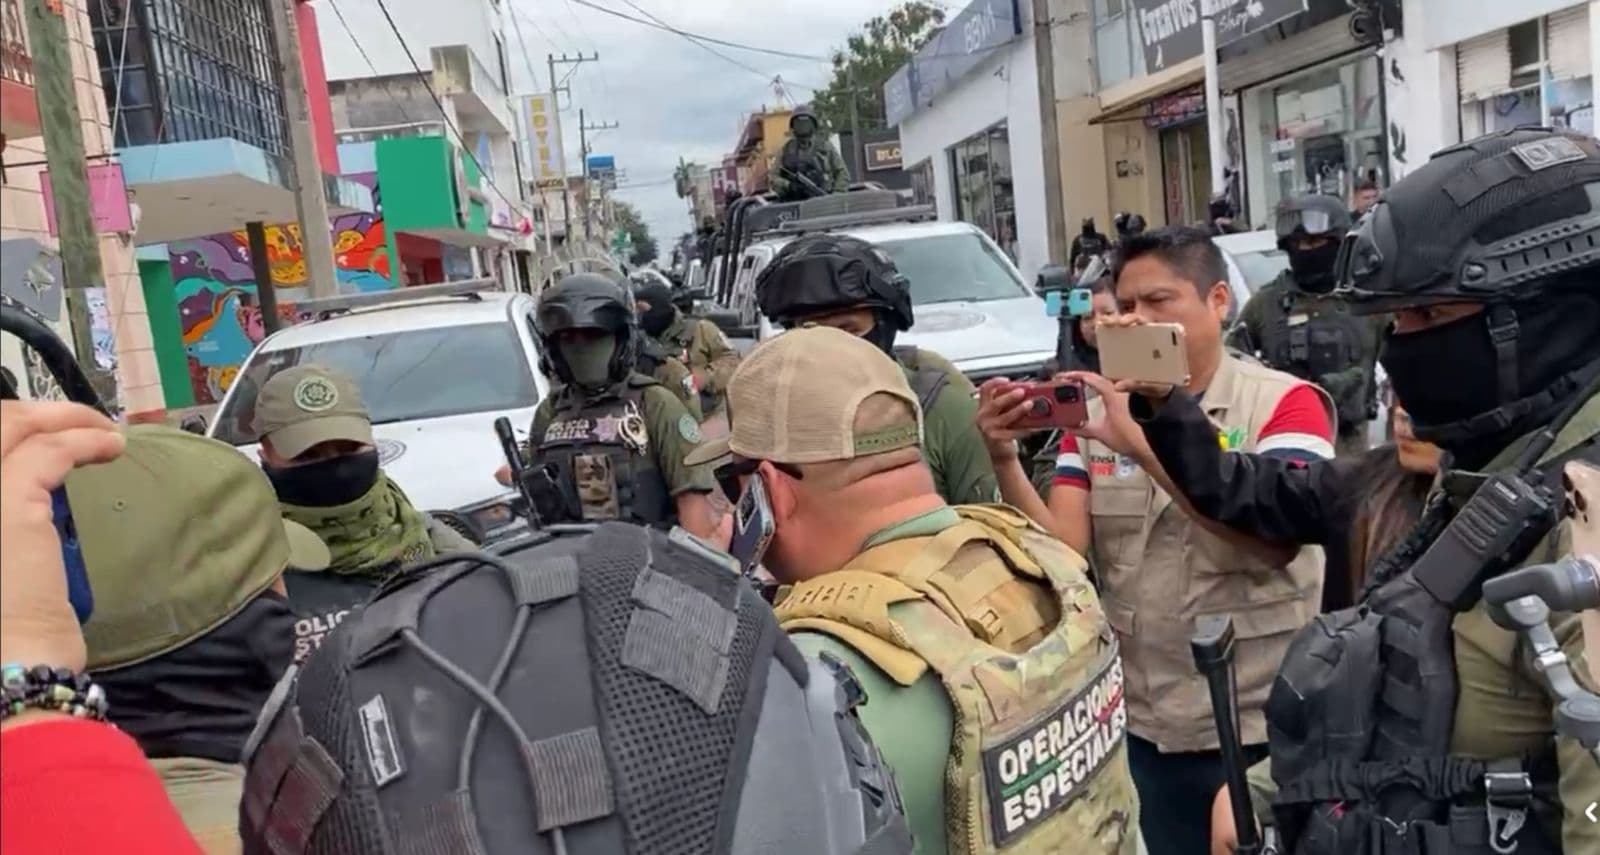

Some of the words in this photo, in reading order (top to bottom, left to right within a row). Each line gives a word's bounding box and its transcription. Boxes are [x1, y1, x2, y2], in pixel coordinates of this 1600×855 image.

[964, 0, 996, 54] BBVA
[530, 96, 552, 177] HOTEL
[998, 655, 1124, 784] OPERACIONES
[1003, 698, 1127, 832] ESPECIALES
